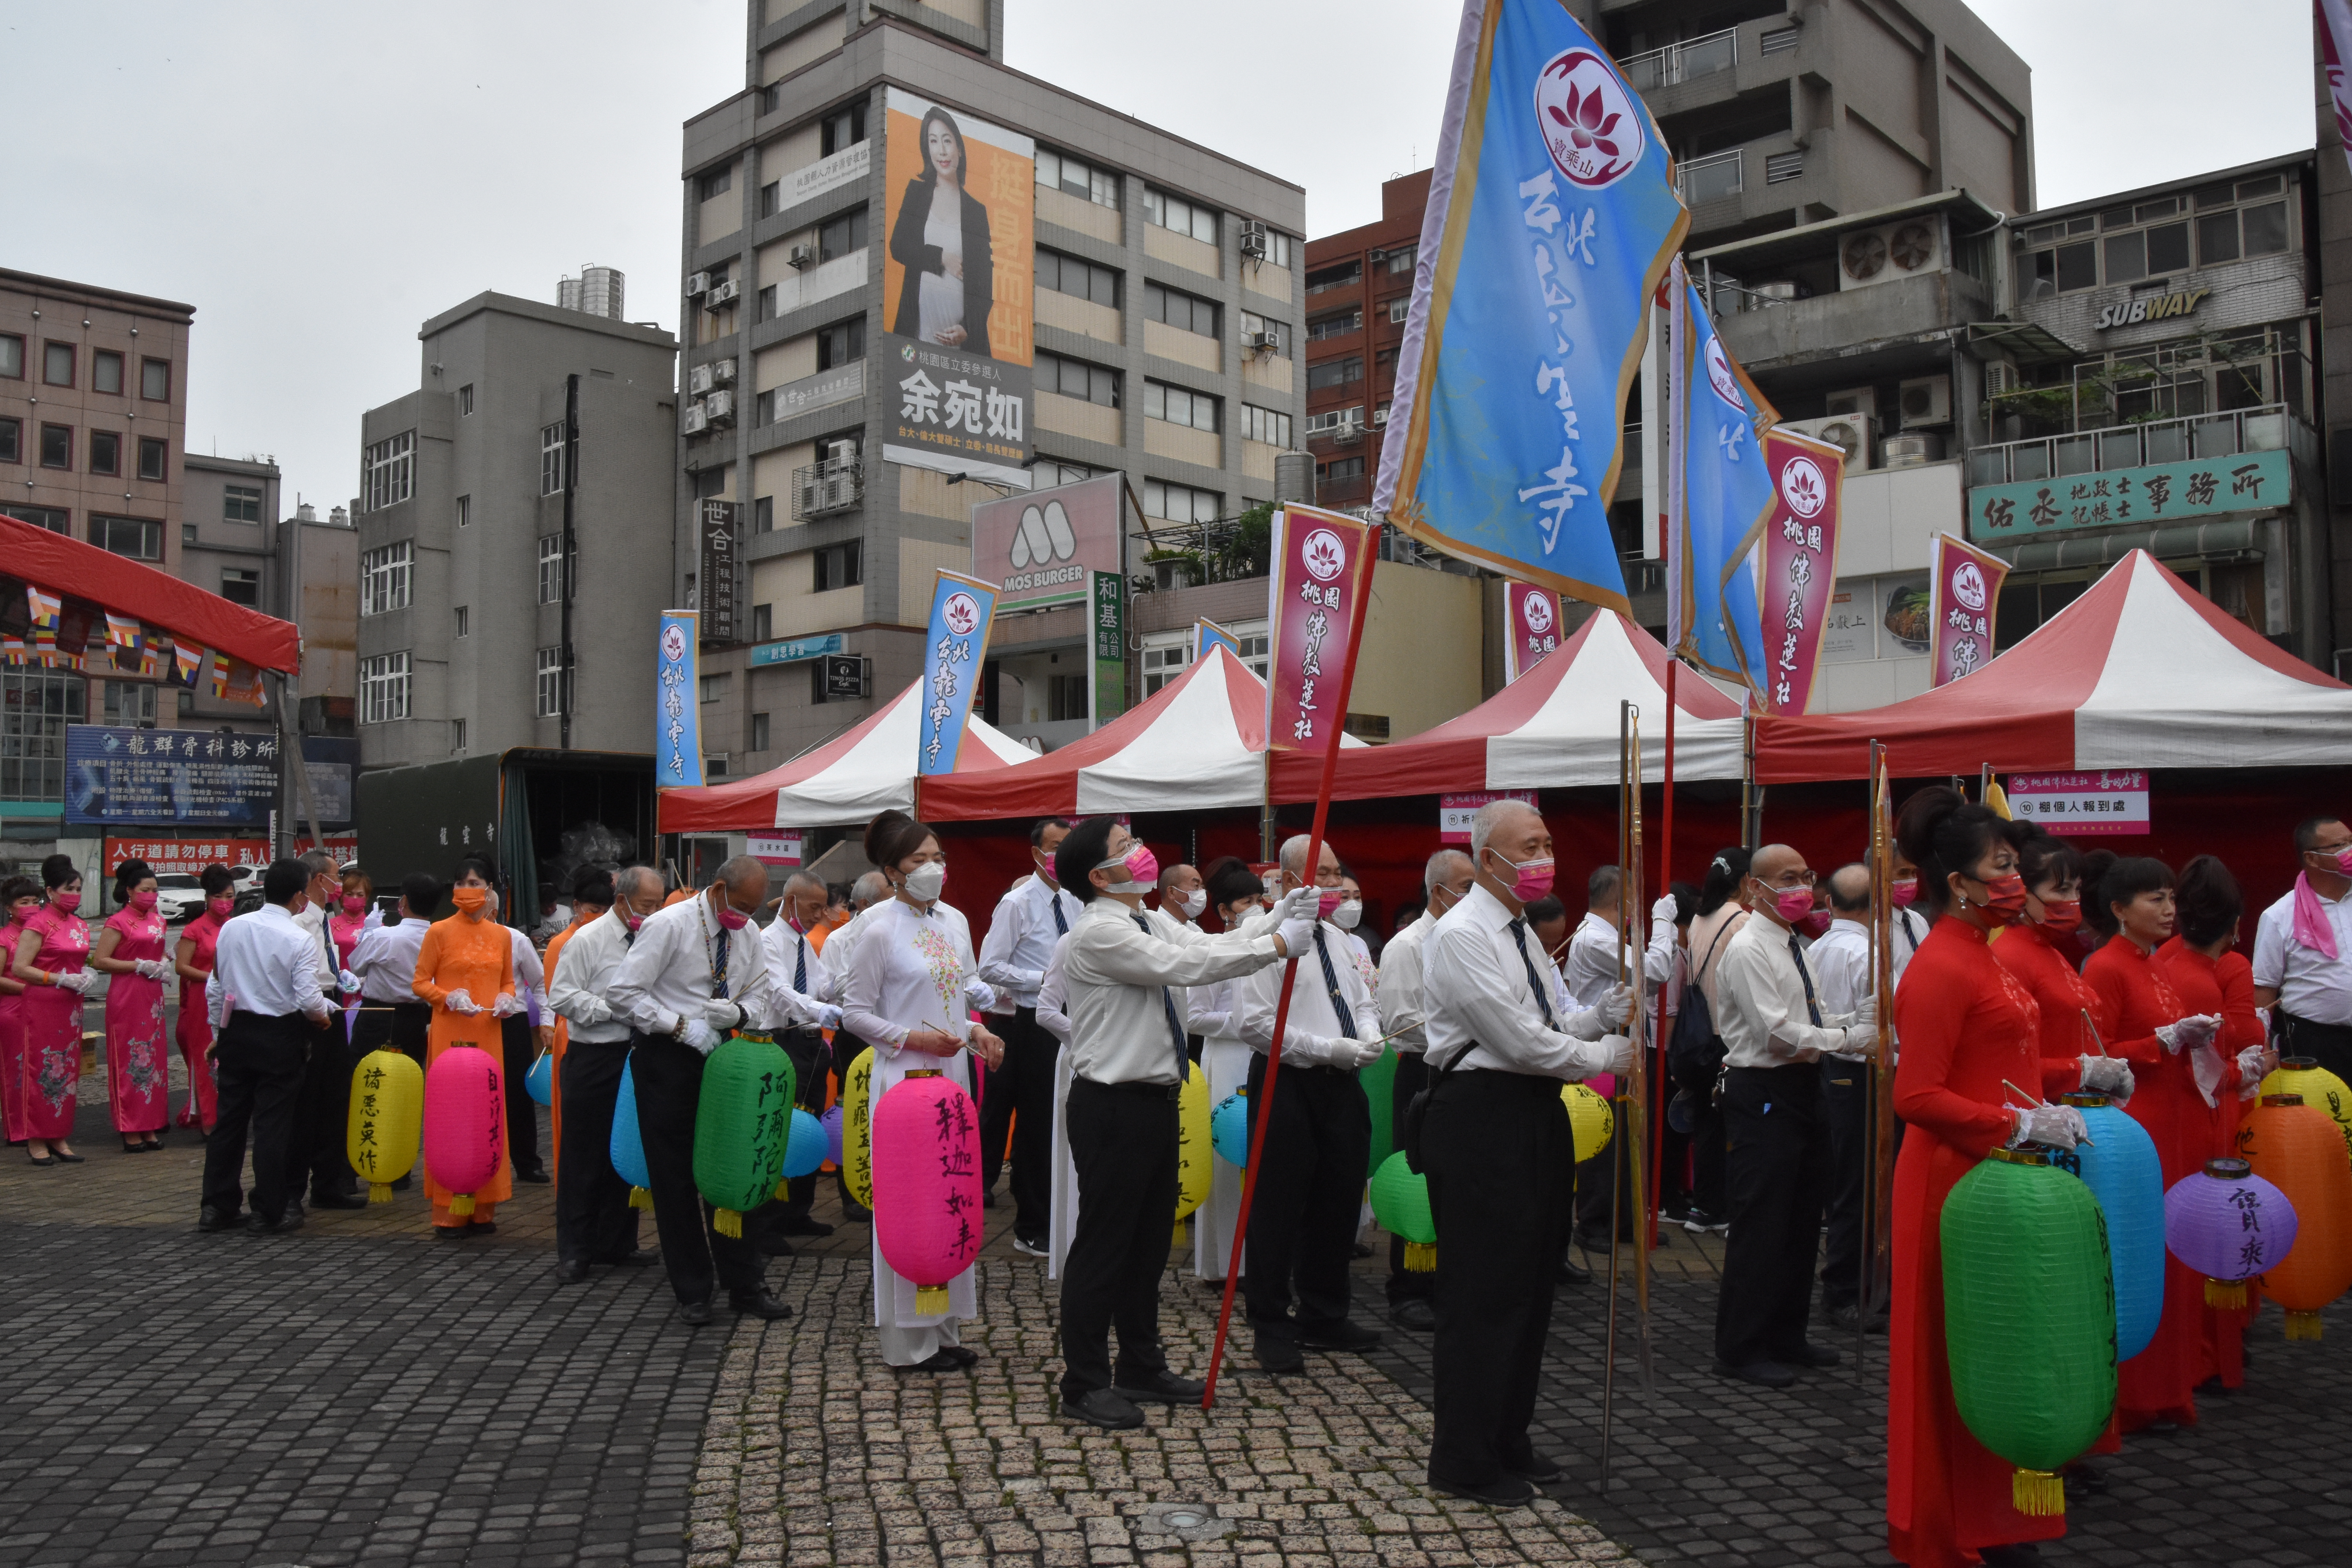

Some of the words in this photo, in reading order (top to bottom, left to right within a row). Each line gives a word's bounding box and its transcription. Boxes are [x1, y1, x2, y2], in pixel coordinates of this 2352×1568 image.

[797, 148, 871, 188] 桃園縣人力資源管理協
[1552, 138, 1594, 177] 寶乘山
[989, 152, 1025, 358] 挺身而出
[2094, 289, 2210, 330] SUBWAY
[918, 350, 1002, 381] 桃園區立委參選人
[899, 368, 1023, 442] 余宛如
[2069, 475, 2132, 501] 地政士
[2143, 463, 2266, 514] 事務所
[1795, 499, 1812, 513] 寶乘山
[2071, 500, 2132, 524] 記帳士
[703, 503, 733, 551] 世合
[1004, 573, 1032, 593] MOS
[1033, 565, 1083, 588] BURGER
[1314, 564, 1330, 576] 寶乘山
[719, 554, 731, 637] 工程技術顧問
[1098, 577, 1118, 628] 和基
[1948, 608, 1987, 639] 桃園
[1528, 634, 1555, 653] 桃園
[126, 735, 275, 760] 龍群骨科診所
[2031, 776, 2088, 789] 桃園佛教蓮社
[2039, 800, 2125, 813] 棚個人報到處
[439, 822, 495, 845] 龍雲寺
[113, 843, 229, 859] 人行道請勿停車
[742, 1070, 788, 1207] 阿彌陀佛
[934, 1092, 975, 1261] 釋迦如來
